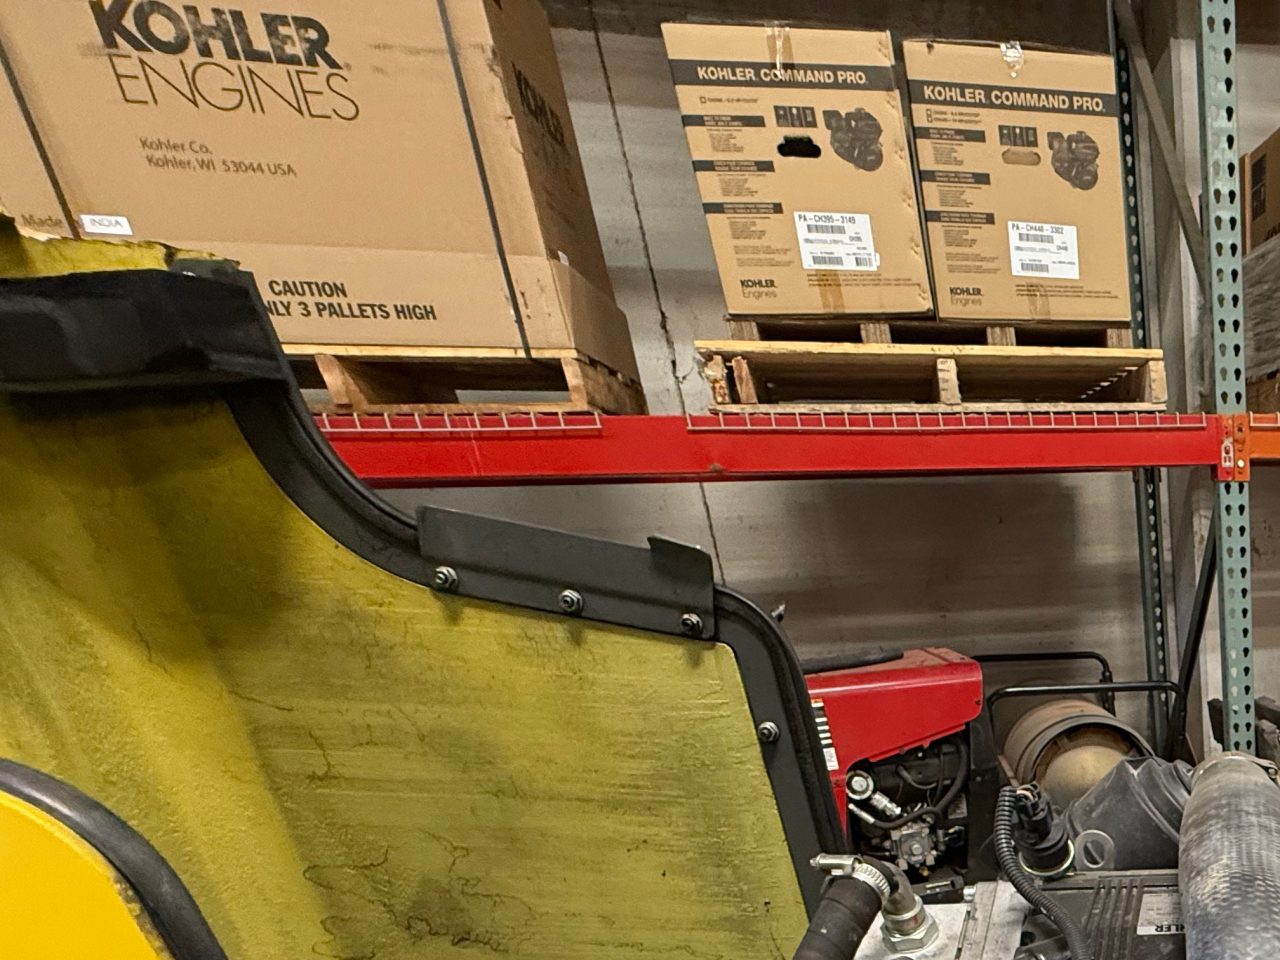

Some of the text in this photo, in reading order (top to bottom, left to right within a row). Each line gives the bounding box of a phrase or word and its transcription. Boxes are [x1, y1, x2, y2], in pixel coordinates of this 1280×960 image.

[88, 0, 343, 70] KOHLER
[697, 67, 867, 84] KOHLER COMMAND PRO
[108, 53, 359, 121] ENGINES
[924, 85, 1104, 112] KOHLER COMMAND PRO
[140, 137, 212, 154] Kohler Co.
[147, 155, 296, 177] Kohler, WI 53044 USA
[268, 280, 348, 298] CAUTION
[740, 279, 778, 289] KOHLER
[950, 287, 983, 297] KOHLER
[742, 288, 778, 300] Engines
[951, 296, 983, 307] Engines
[265, 301, 438, 321] NLY 3 PALLETS HIGH
